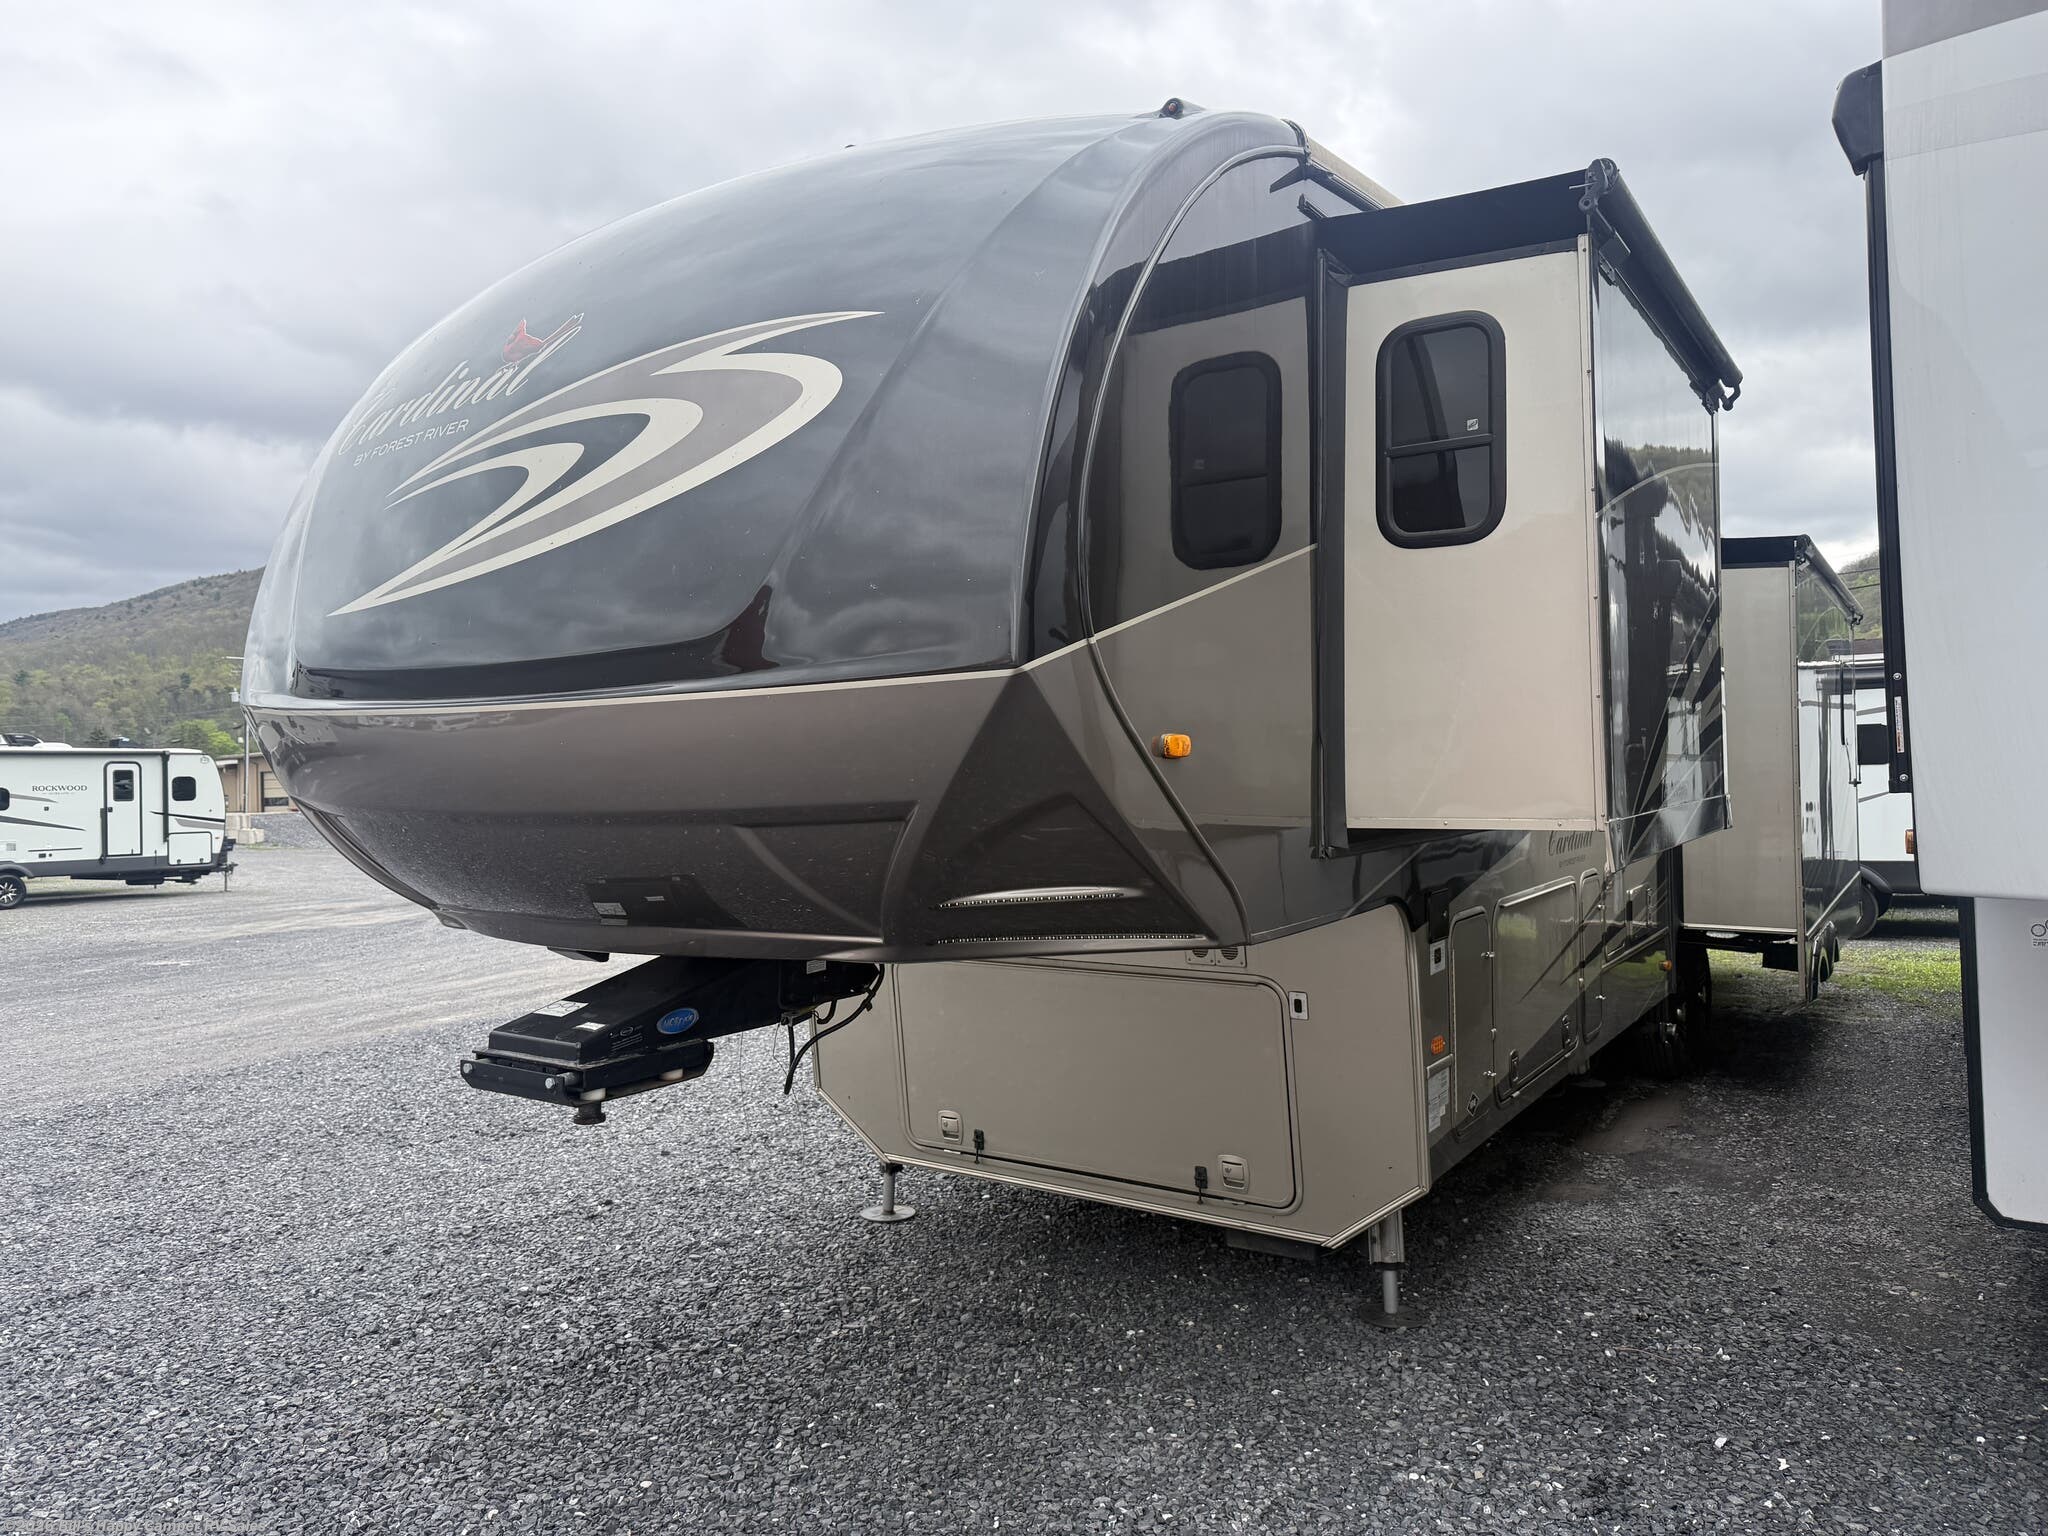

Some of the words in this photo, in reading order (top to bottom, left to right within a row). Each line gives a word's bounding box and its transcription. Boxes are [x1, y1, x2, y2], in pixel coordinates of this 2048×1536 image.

[338, 325, 583, 456] Cardinal
[353, 449, 373, 467] BY
[370, 431, 424, 459] FOREST
[424, 418, 469, 441] RIVER
